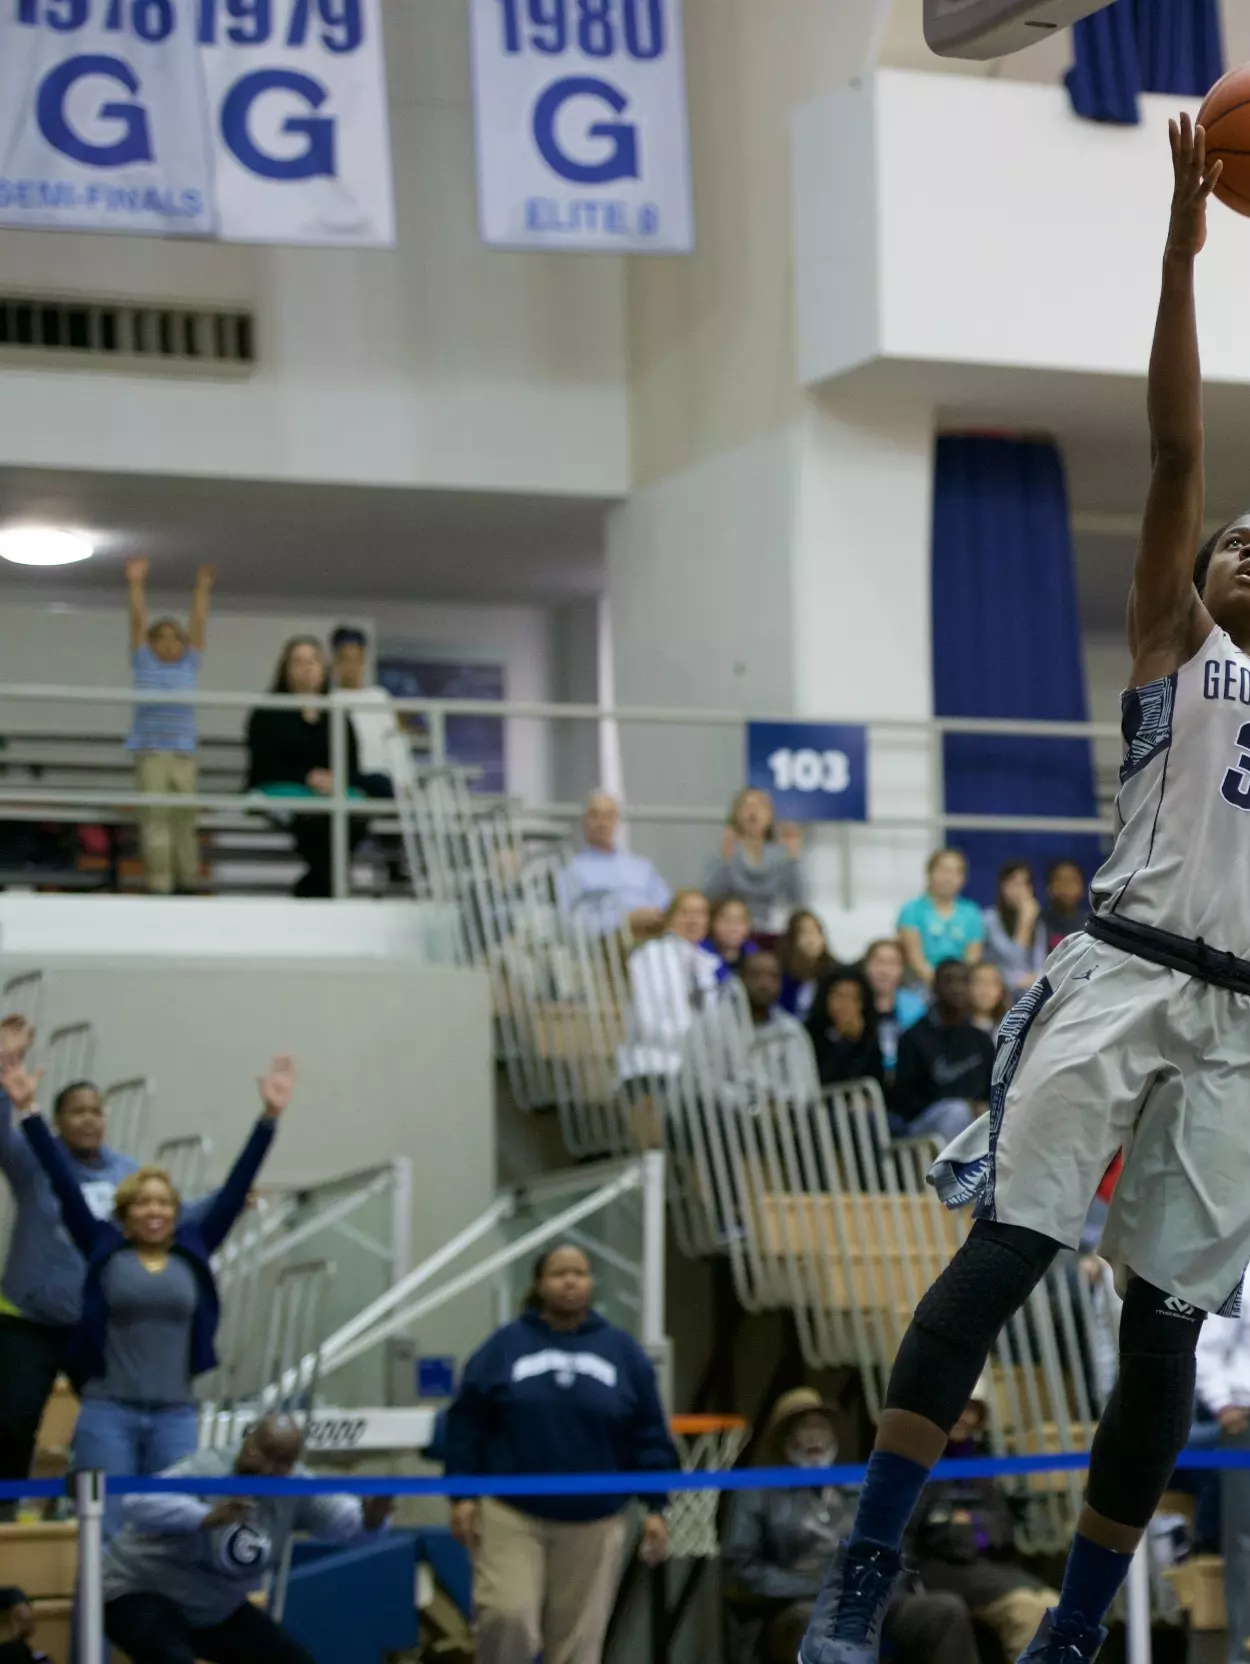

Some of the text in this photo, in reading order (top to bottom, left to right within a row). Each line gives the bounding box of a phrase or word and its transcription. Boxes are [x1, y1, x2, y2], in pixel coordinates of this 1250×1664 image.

[500, 0, 665, 61] 1980
[36, 54, 156, 169] G
[220, 68, 336, 182] G
[532, 75, 640, 184] G
[767, 747, 851, 794] 103
